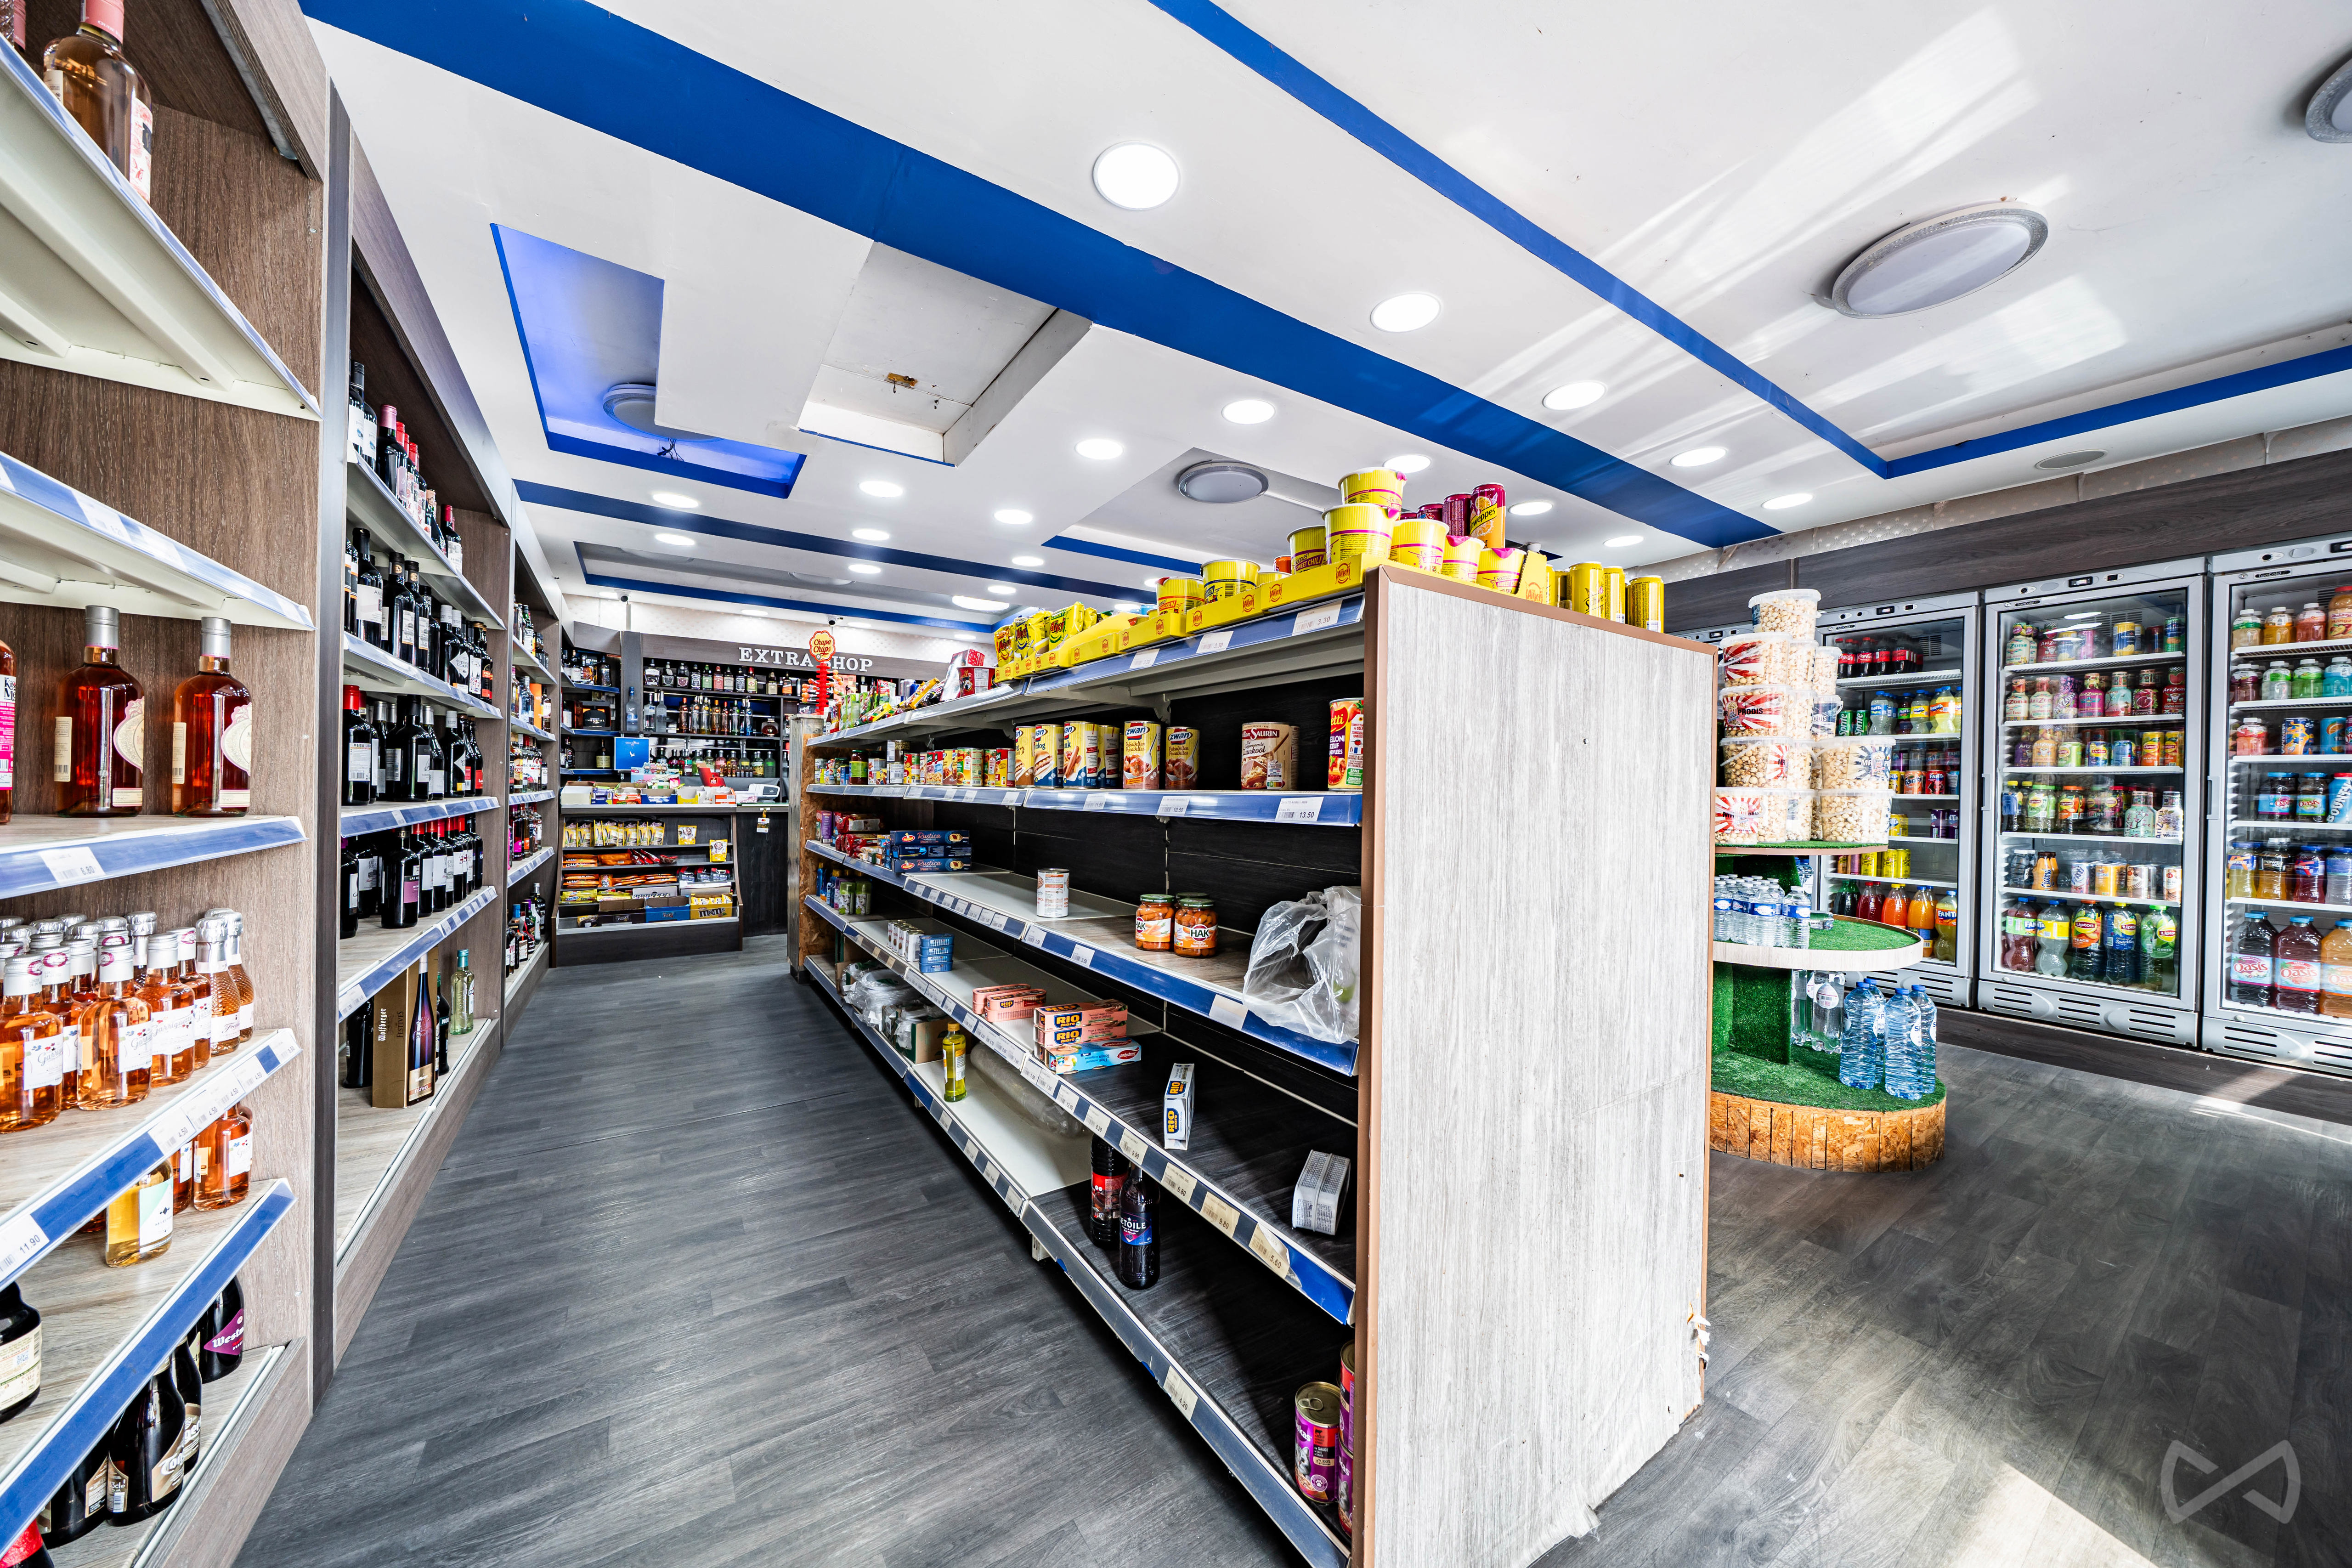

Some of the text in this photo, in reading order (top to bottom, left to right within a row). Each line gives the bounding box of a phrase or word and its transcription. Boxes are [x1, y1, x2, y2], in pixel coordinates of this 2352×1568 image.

[1295, 556, 1322, 571] SWEET CHILI
[1317, 616, 1331, 625] 3.30
[814, 639, 831, 648] Chupa
[814, 645, 831, 654] Chups
[739, 647, 814, 668] EXTRA
[1331, 714, 1345, 726] etti
[1839, 713, 1849, 737] Sprite
[1854, 713, 1864, 736] Sprite
[1126, 727, 1146, 736] zwan
[1170, 732, 1190, 741] zwan
[1250, 728, 1278, 740] SAURIN
[2326, 781, 2351, 822] BOUNTY
[1190, 929, 1209, 938] HAK
[2233, 962, 2268, 972] Oasis
[2280, 968, 2318, 978] Oasis
[2328, 975, 2352, 984] Oas
[378, 1008, 388, 1042] Wolfberger
[396, 1011, 405, 1038] FESTIVES
[1057, 1014, 1080, 1025] RIO
[1057, 1030, 1080, 1041] RIO
[231, 1087, 239, 1097] 4.50
[1170, 1081, 1181, 1094] RIO
[209, 1106, 218, 1116] 4.50
[178, 1126, 188, 1138] 4.50
[1131, 1150, 1140, 1160] 9.90
[1177, 1186, 1187, 1197] 6.80
[1219, 1217, 1230, 1230] 9.80
[19, 1234, 41, 1254] 11.90
[1270, 1255, 1282, 1269] 5.60
